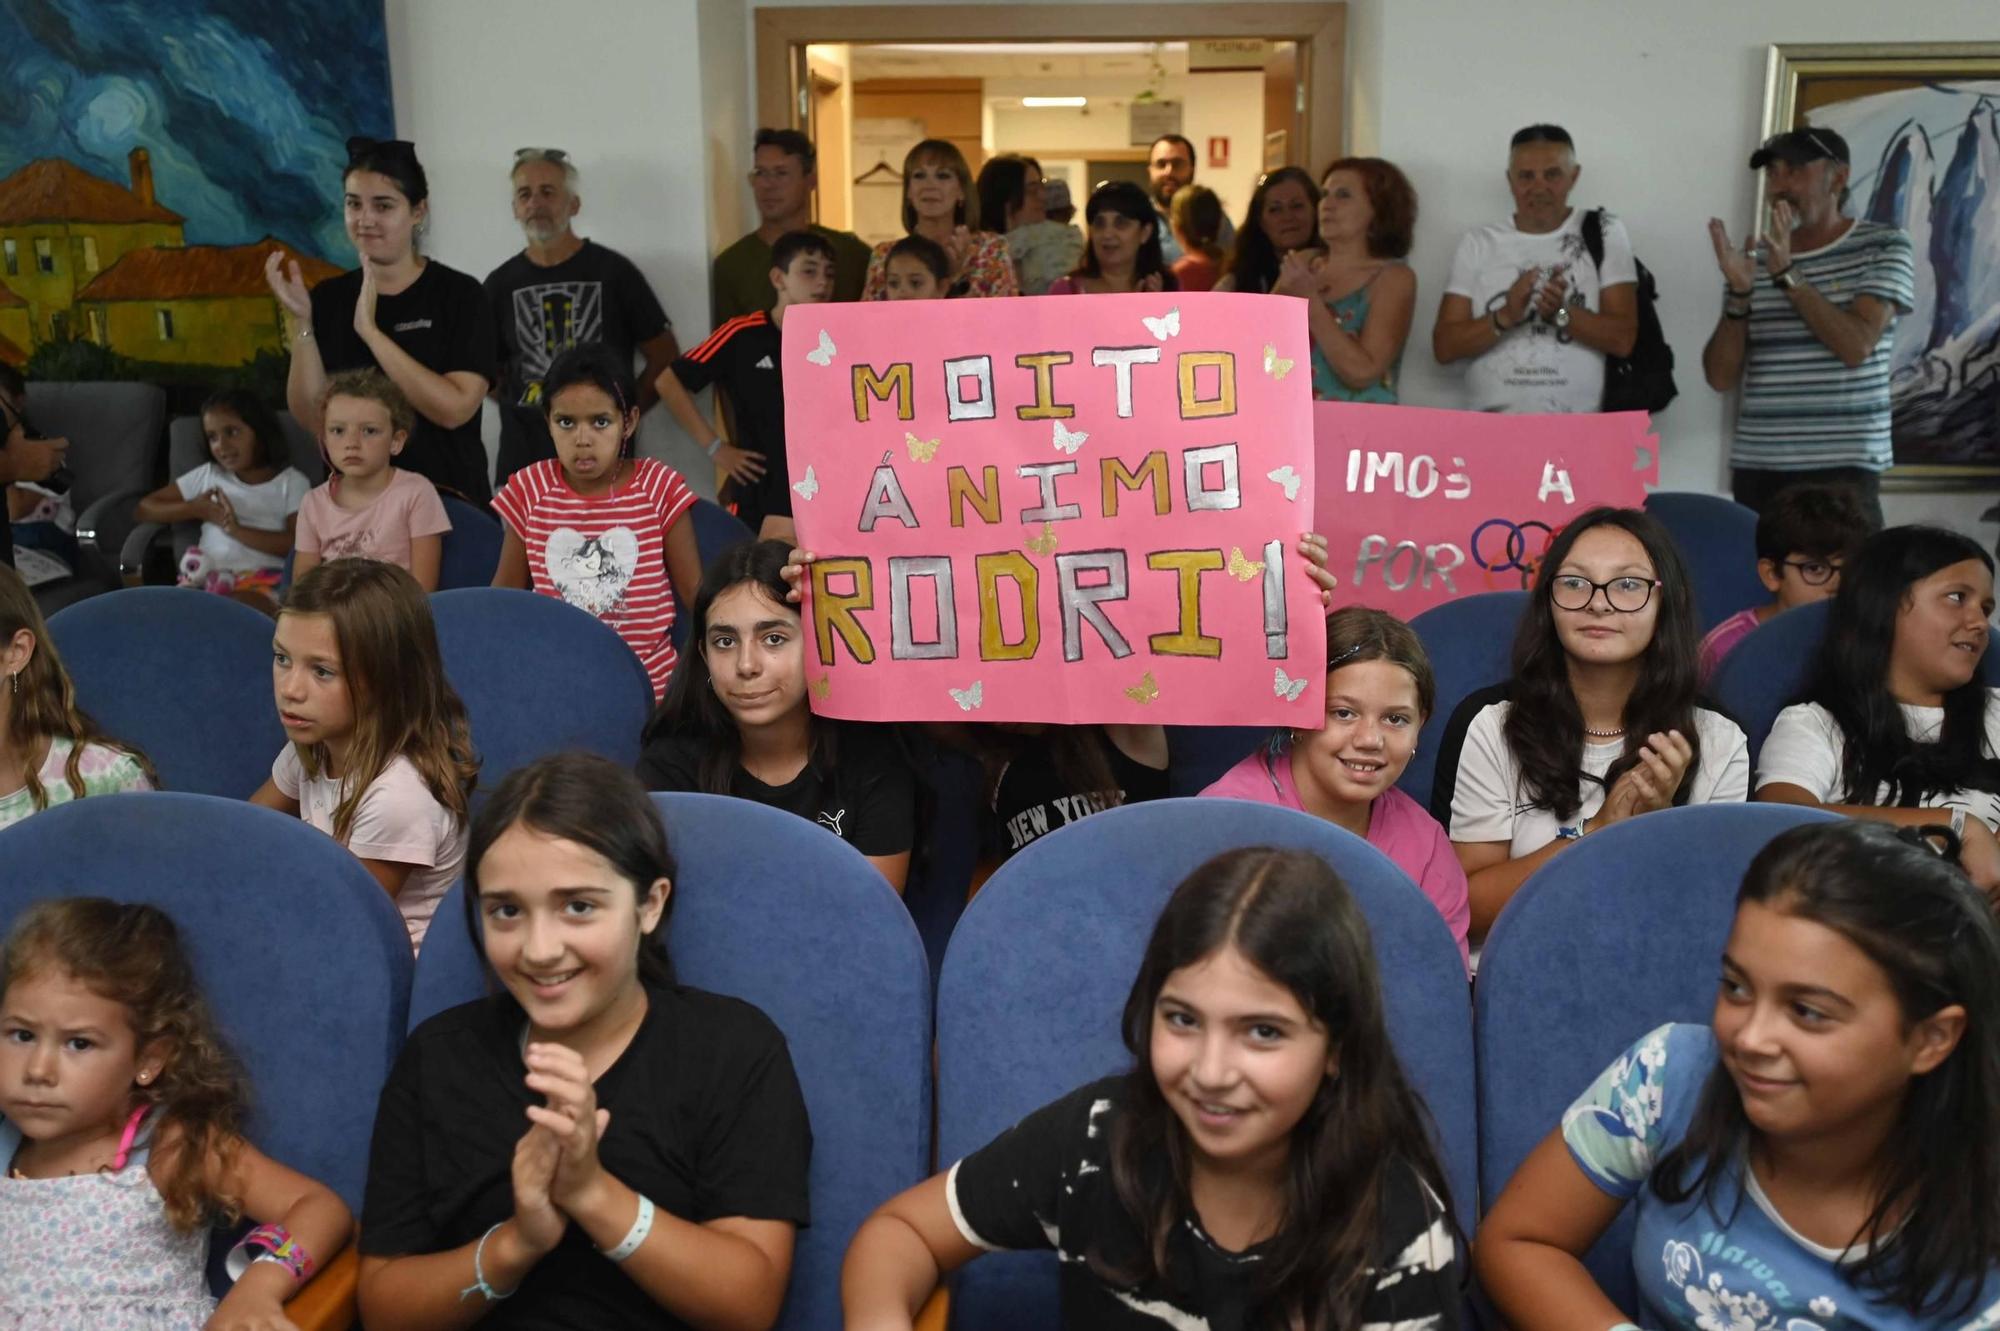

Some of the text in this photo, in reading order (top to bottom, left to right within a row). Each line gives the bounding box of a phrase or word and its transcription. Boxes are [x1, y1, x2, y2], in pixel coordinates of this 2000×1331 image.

[851, 345, 1237, 422] MOITO
[857, 442, 1242, 532] ÁNIMO
[1346, 449, 1575, 504] IMOS A
[1353, 534, 1465, 593] POR
[809, 539, 1288, 665] RODRI!
[1006, 790, 1127, 849] NEW YO
